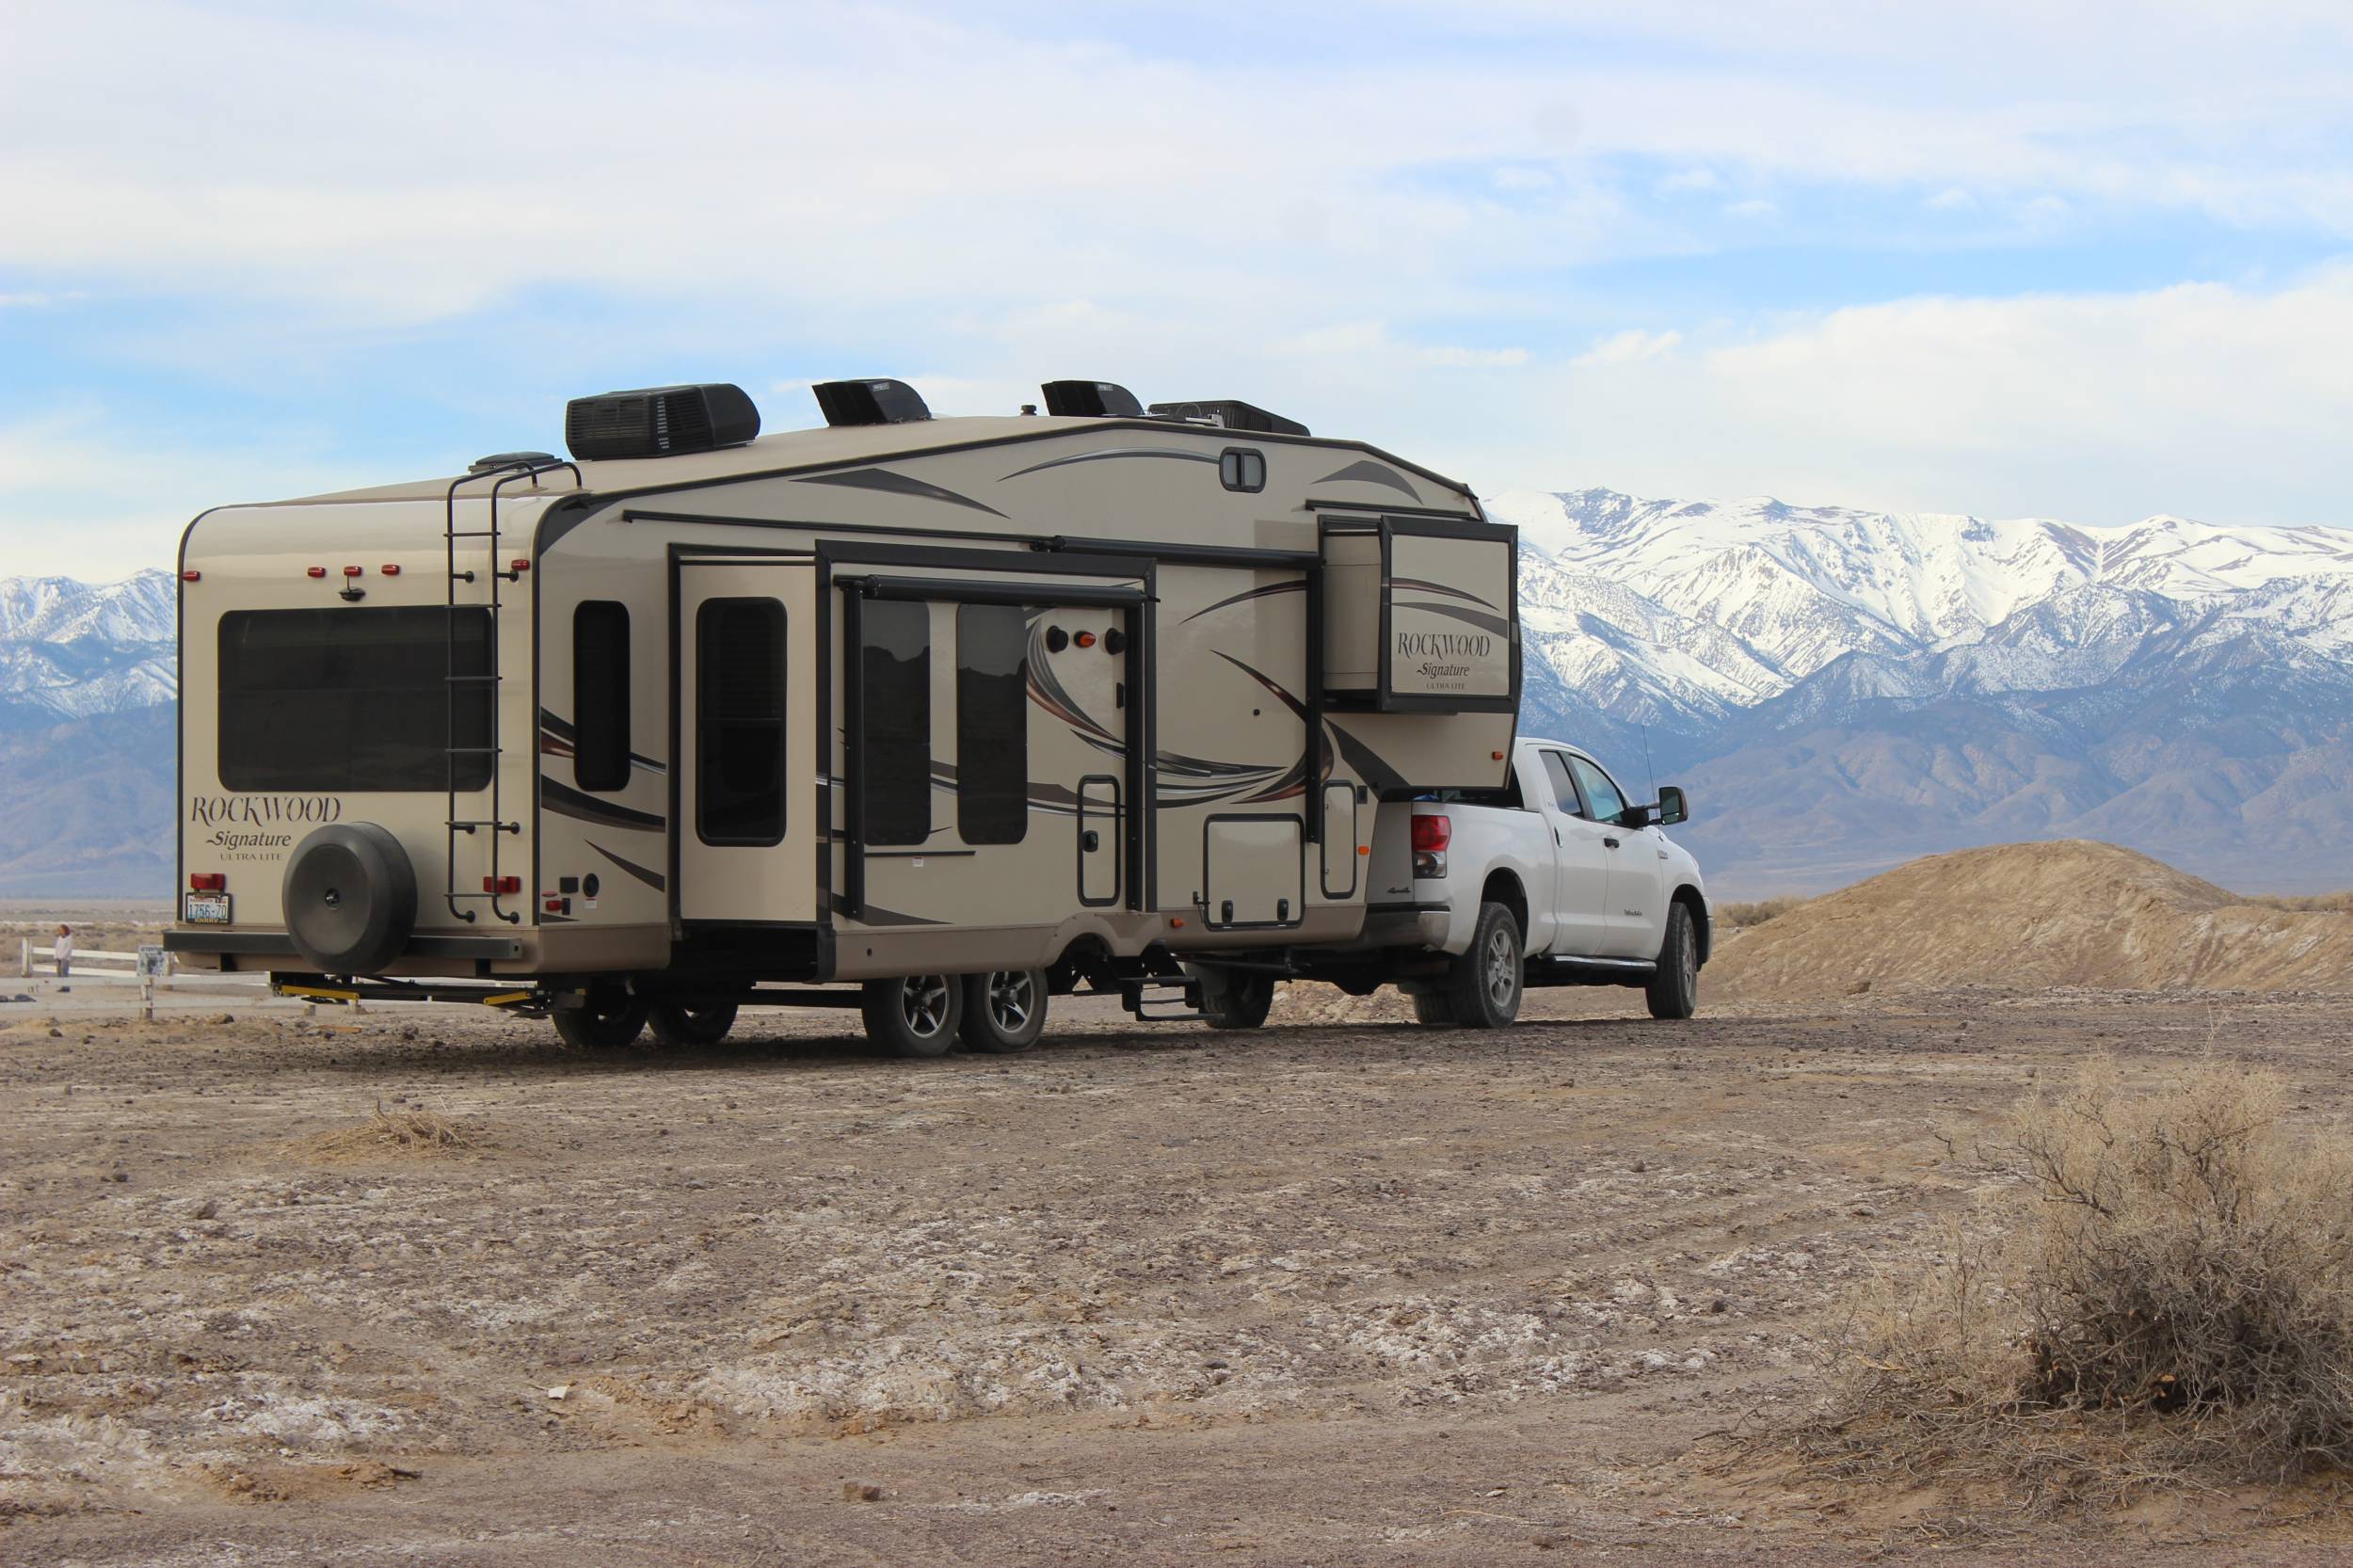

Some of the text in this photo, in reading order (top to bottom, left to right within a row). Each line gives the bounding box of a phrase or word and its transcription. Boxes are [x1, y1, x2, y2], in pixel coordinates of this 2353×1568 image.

[1398, 632, 1490, 661] ROCKWOOD
[1417, 662, 1470, 680] Signature
[191, 796, 342, 827] ROCKWOOD
[207, 830, 292, 850] Signature
[260, 853, 282, 861] LITE
